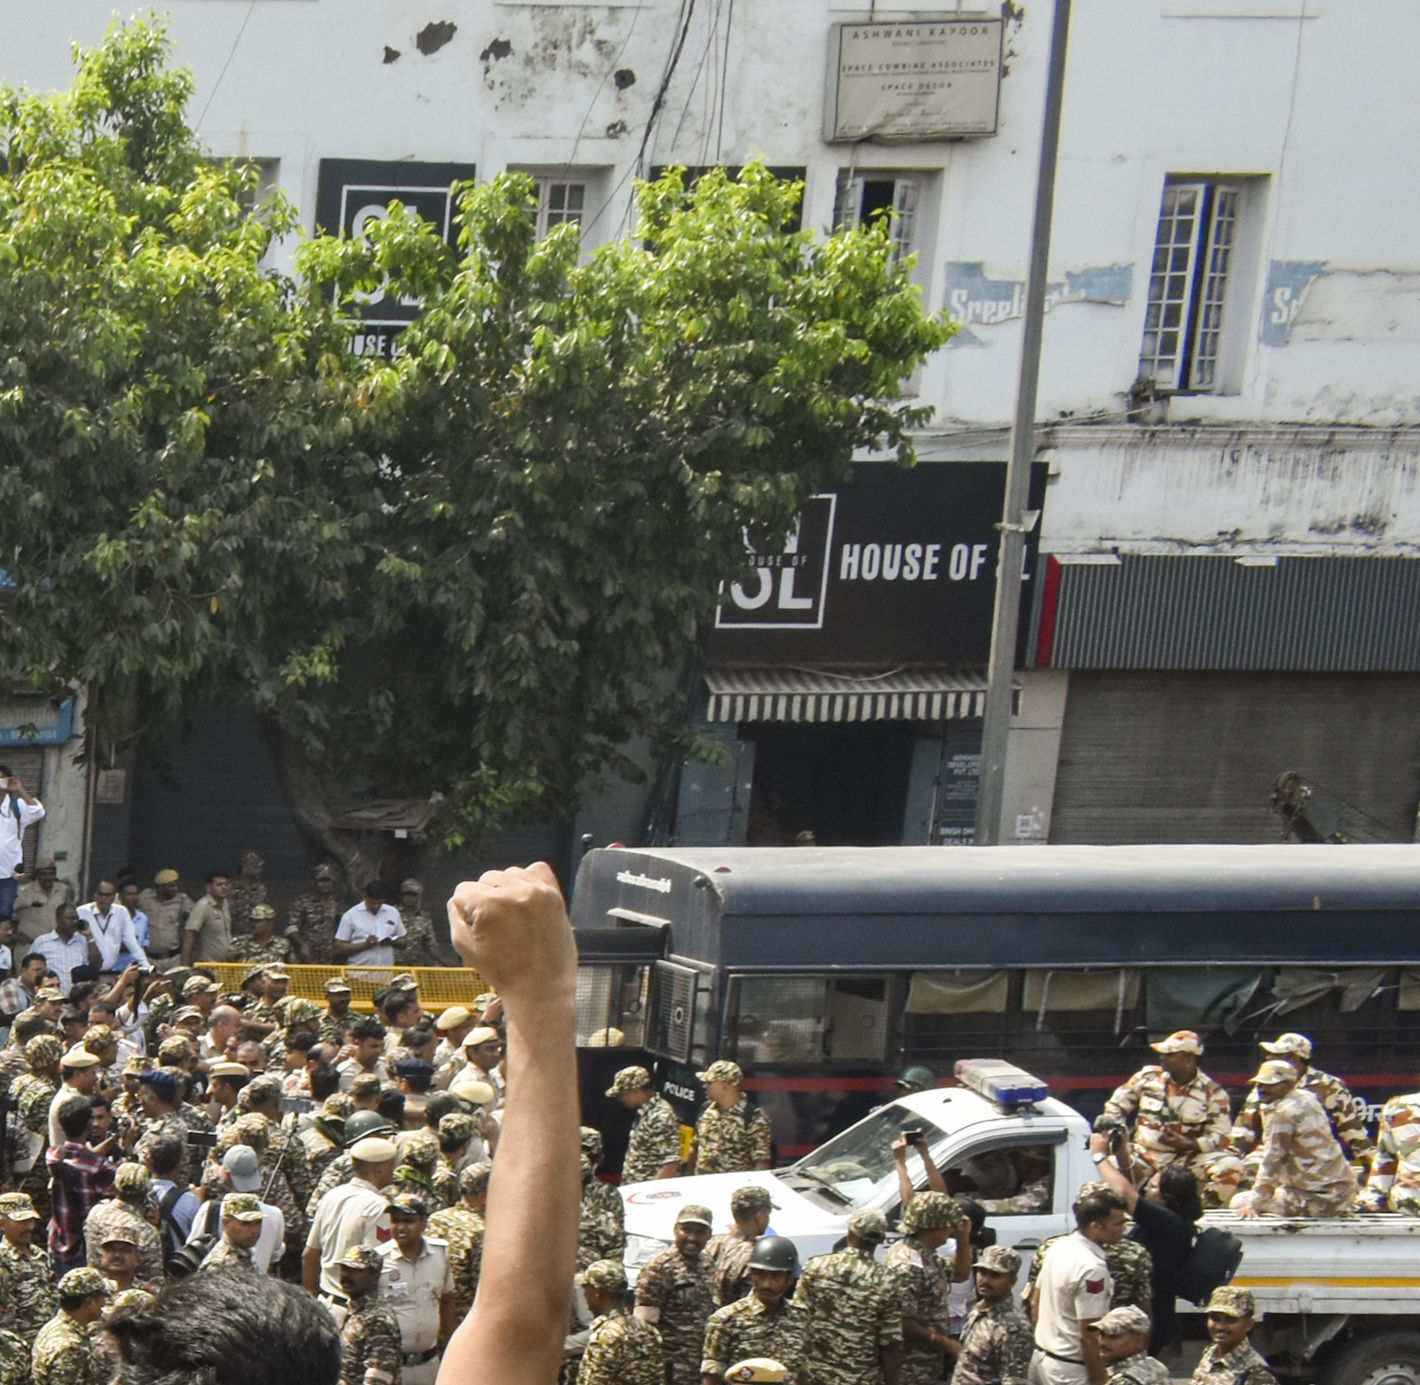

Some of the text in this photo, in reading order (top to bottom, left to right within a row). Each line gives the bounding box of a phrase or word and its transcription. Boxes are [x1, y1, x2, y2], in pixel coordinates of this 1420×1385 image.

[852, 26, 989, 40] ASHWANI KAPOOR
[745, 553, 808, 567] OUSE OF
[840, 544, 941, 580] HOUSE
[949, 544, 988, 581] OF
[663, 1081, 696, 1101] POLICE
